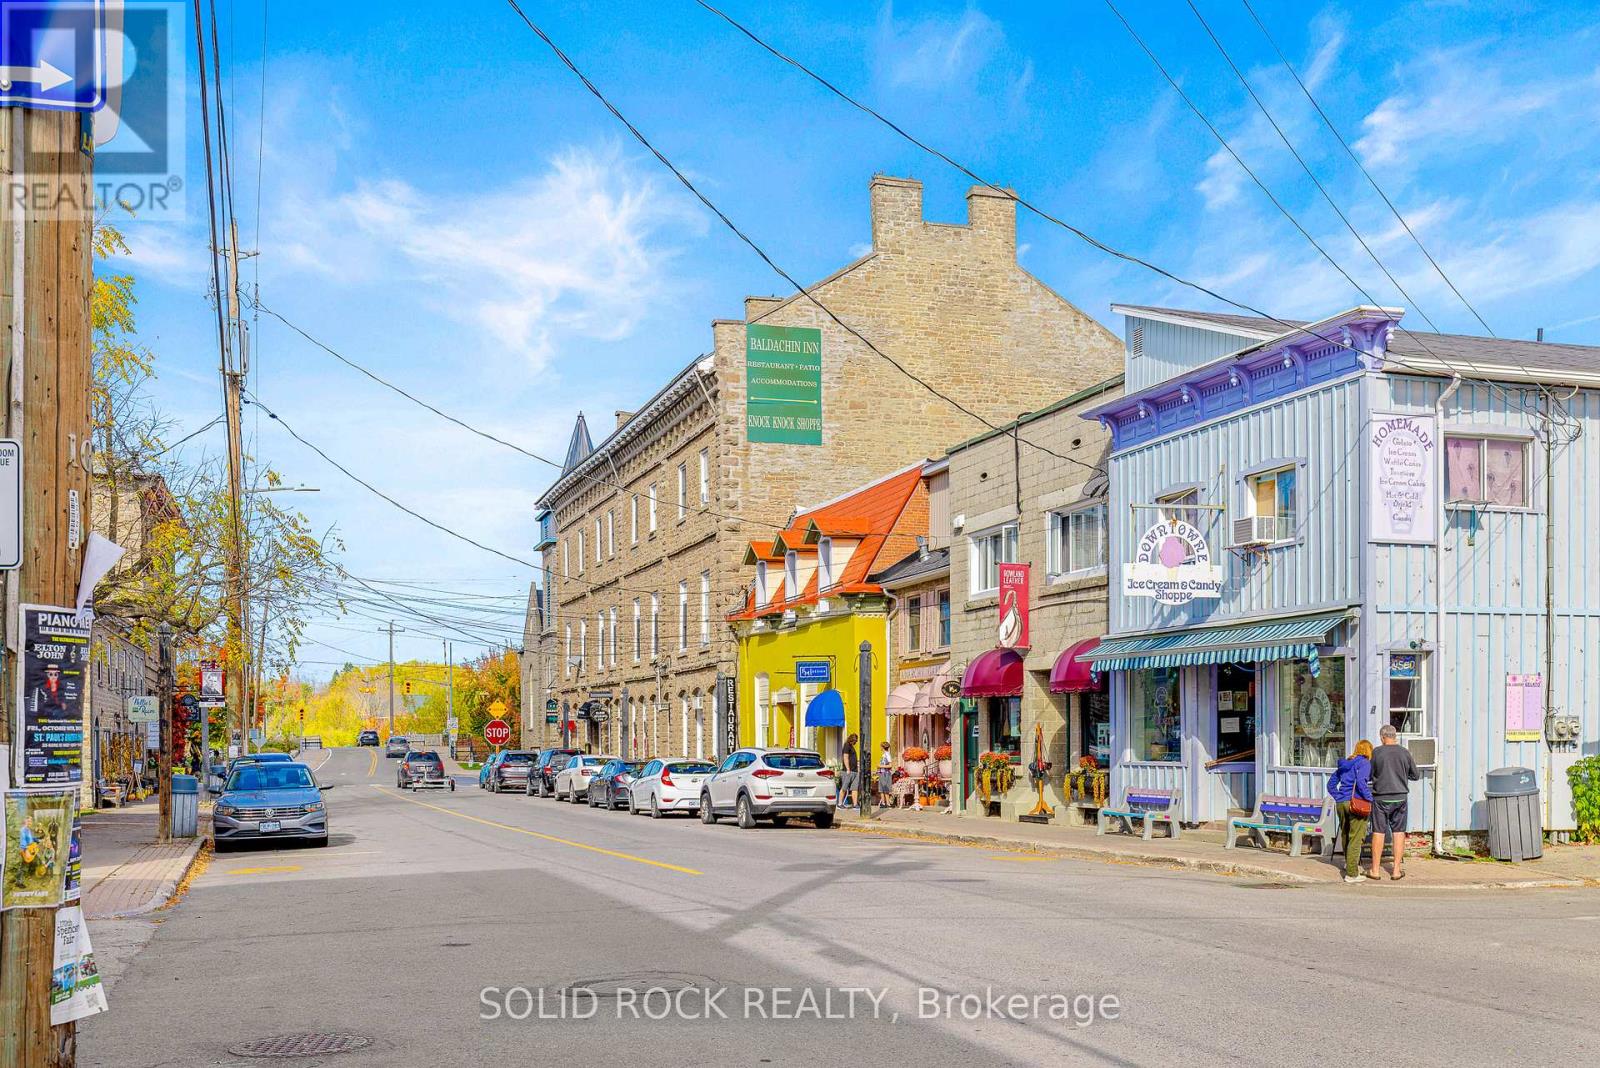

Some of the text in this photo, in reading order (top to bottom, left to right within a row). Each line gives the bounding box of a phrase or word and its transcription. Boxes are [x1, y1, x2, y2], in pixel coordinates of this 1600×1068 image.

[750, 337, 820, 354] BALDACHIN INN
[747, 361, 820, 372] RESTAURANT PATIO
[750, 377, 817, 388] ACCOMMODATIONS
[748, 414, 821, 431] KNOCK KNOCK SHOPPE
[1372, 418, 1434, 452] HOMEMADE
[1138, 522, 1208, 563] DOWNTOWNE
[1128, 579, 1145, 590] Ice
[1145, 579, 1180, 590] Cream
[1188, 579, 1222, 593] Candy
[1155, 590, 1193, 602] Shoppe
[33, 643, 67, 653] ELTON
[36, 651, 64, 660] JOHN
[727, 679, 735, 754] RESTAURANT
[486, 727, 509, 738] STOP
